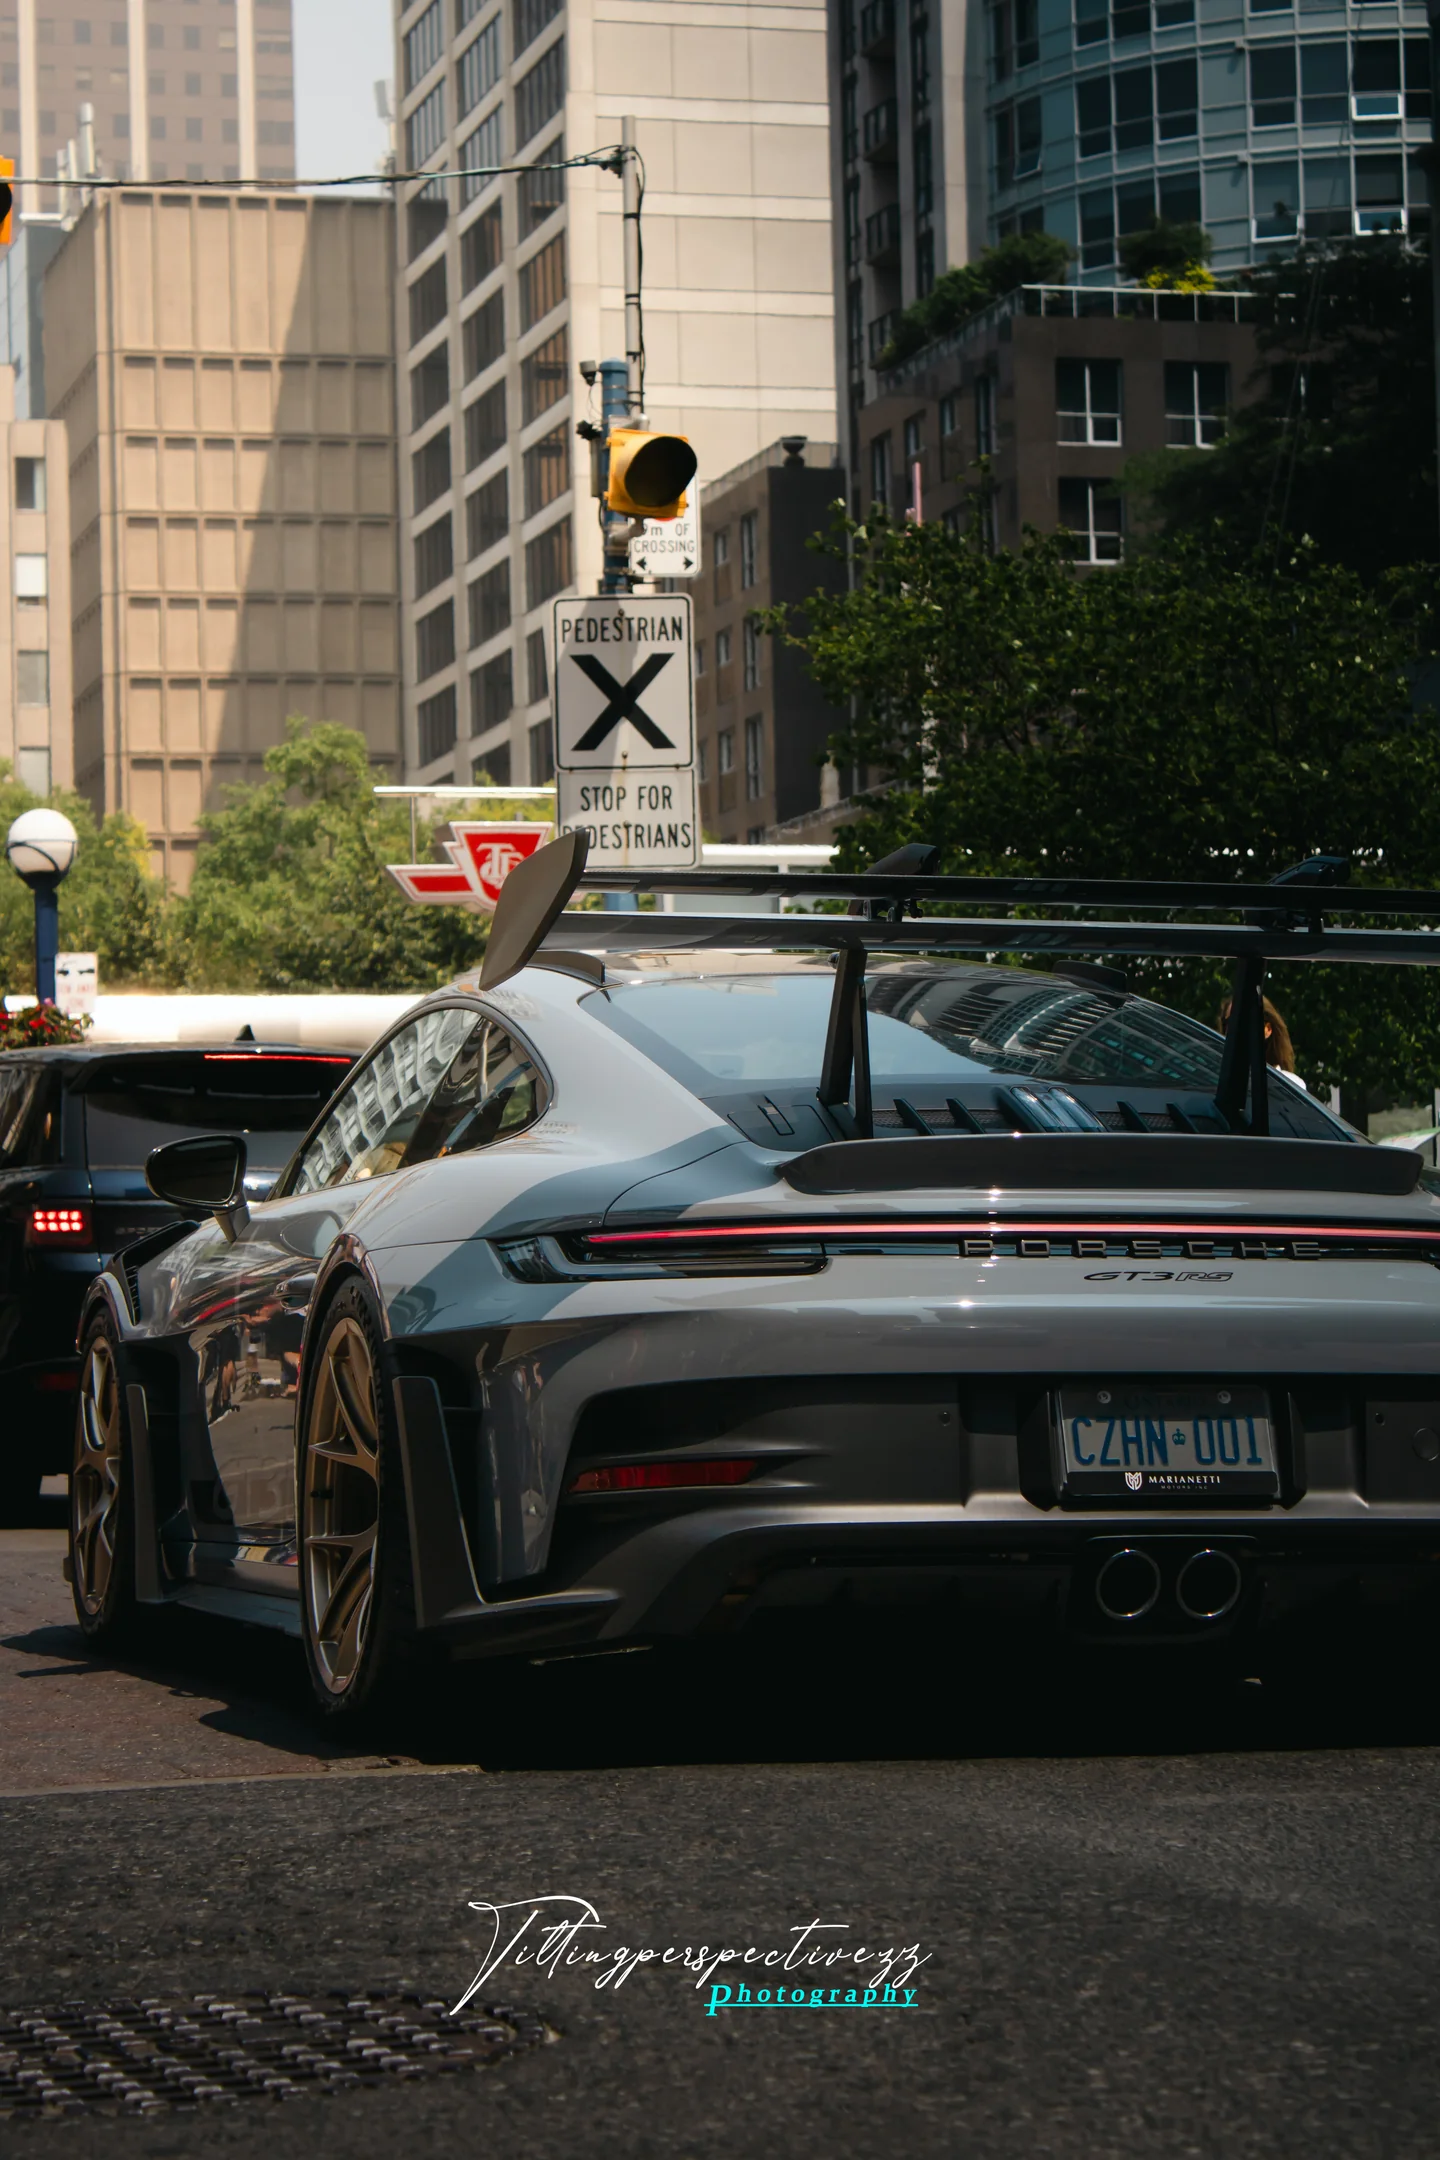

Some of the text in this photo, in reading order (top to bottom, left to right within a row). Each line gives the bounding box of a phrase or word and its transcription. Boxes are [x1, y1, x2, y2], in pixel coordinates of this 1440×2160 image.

[675, 523, 691, 537] OF
[634, 539, 695, 553] CROSSING
[562, 616, 684, 643] PEDESTRIAN
[580, 785, 673, 811] STOP FOR
[562, 823, 692, 850] DESTRIANS
[963, 1239, 1321, 1259] PORSCHE
[1071, 1416, 1263, 1466] CZHN 001
[1148, 1476, 1222, 1484] MARIANETTI
